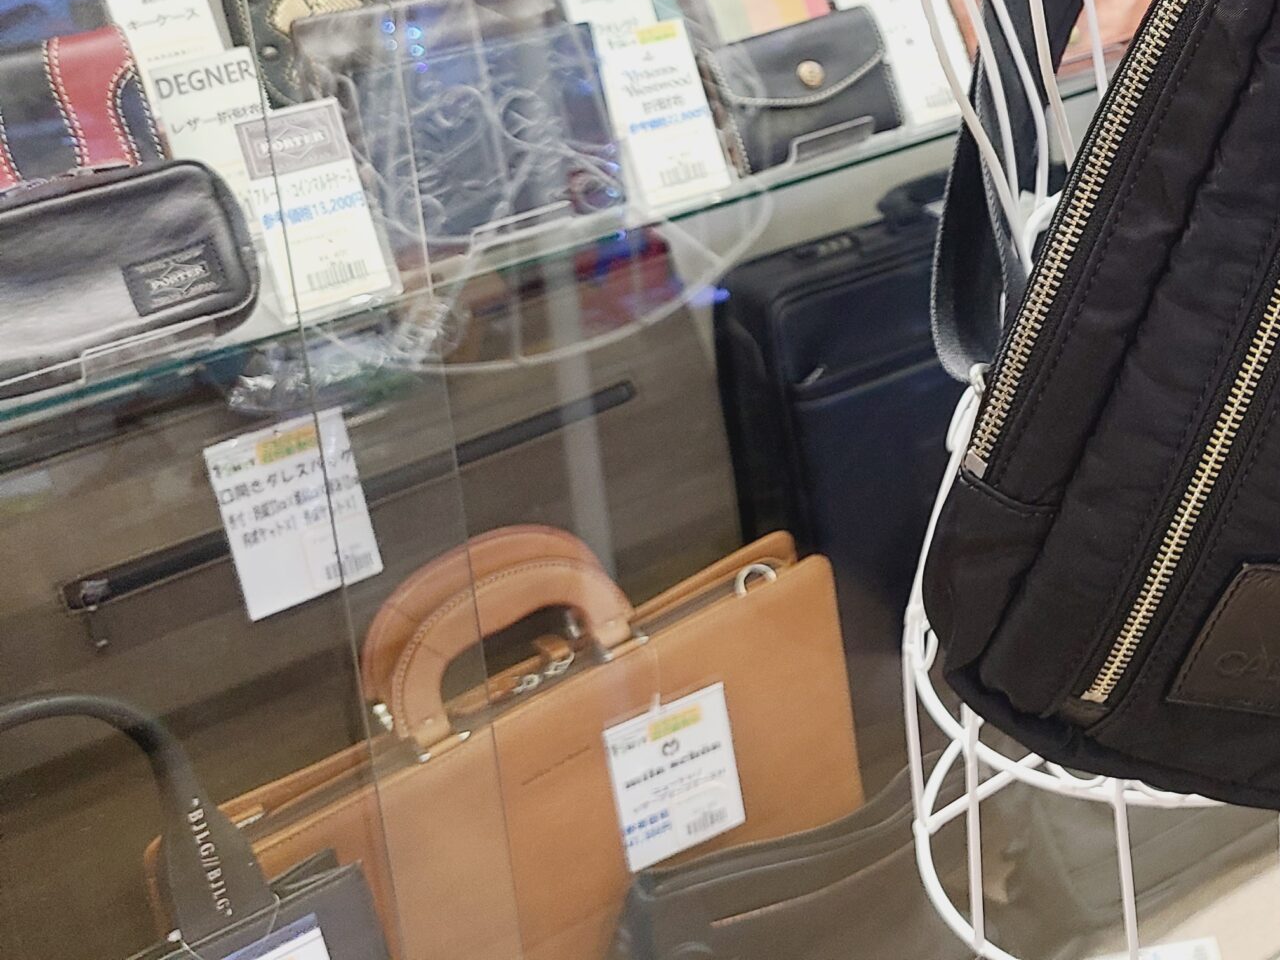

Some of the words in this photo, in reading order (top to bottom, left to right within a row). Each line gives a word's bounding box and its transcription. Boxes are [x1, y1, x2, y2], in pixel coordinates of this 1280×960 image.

[127, 7, 201, 31] キーケース
[154, 59, 258, 100] DEGNER
[260, 129, 327, 155] PORTER
